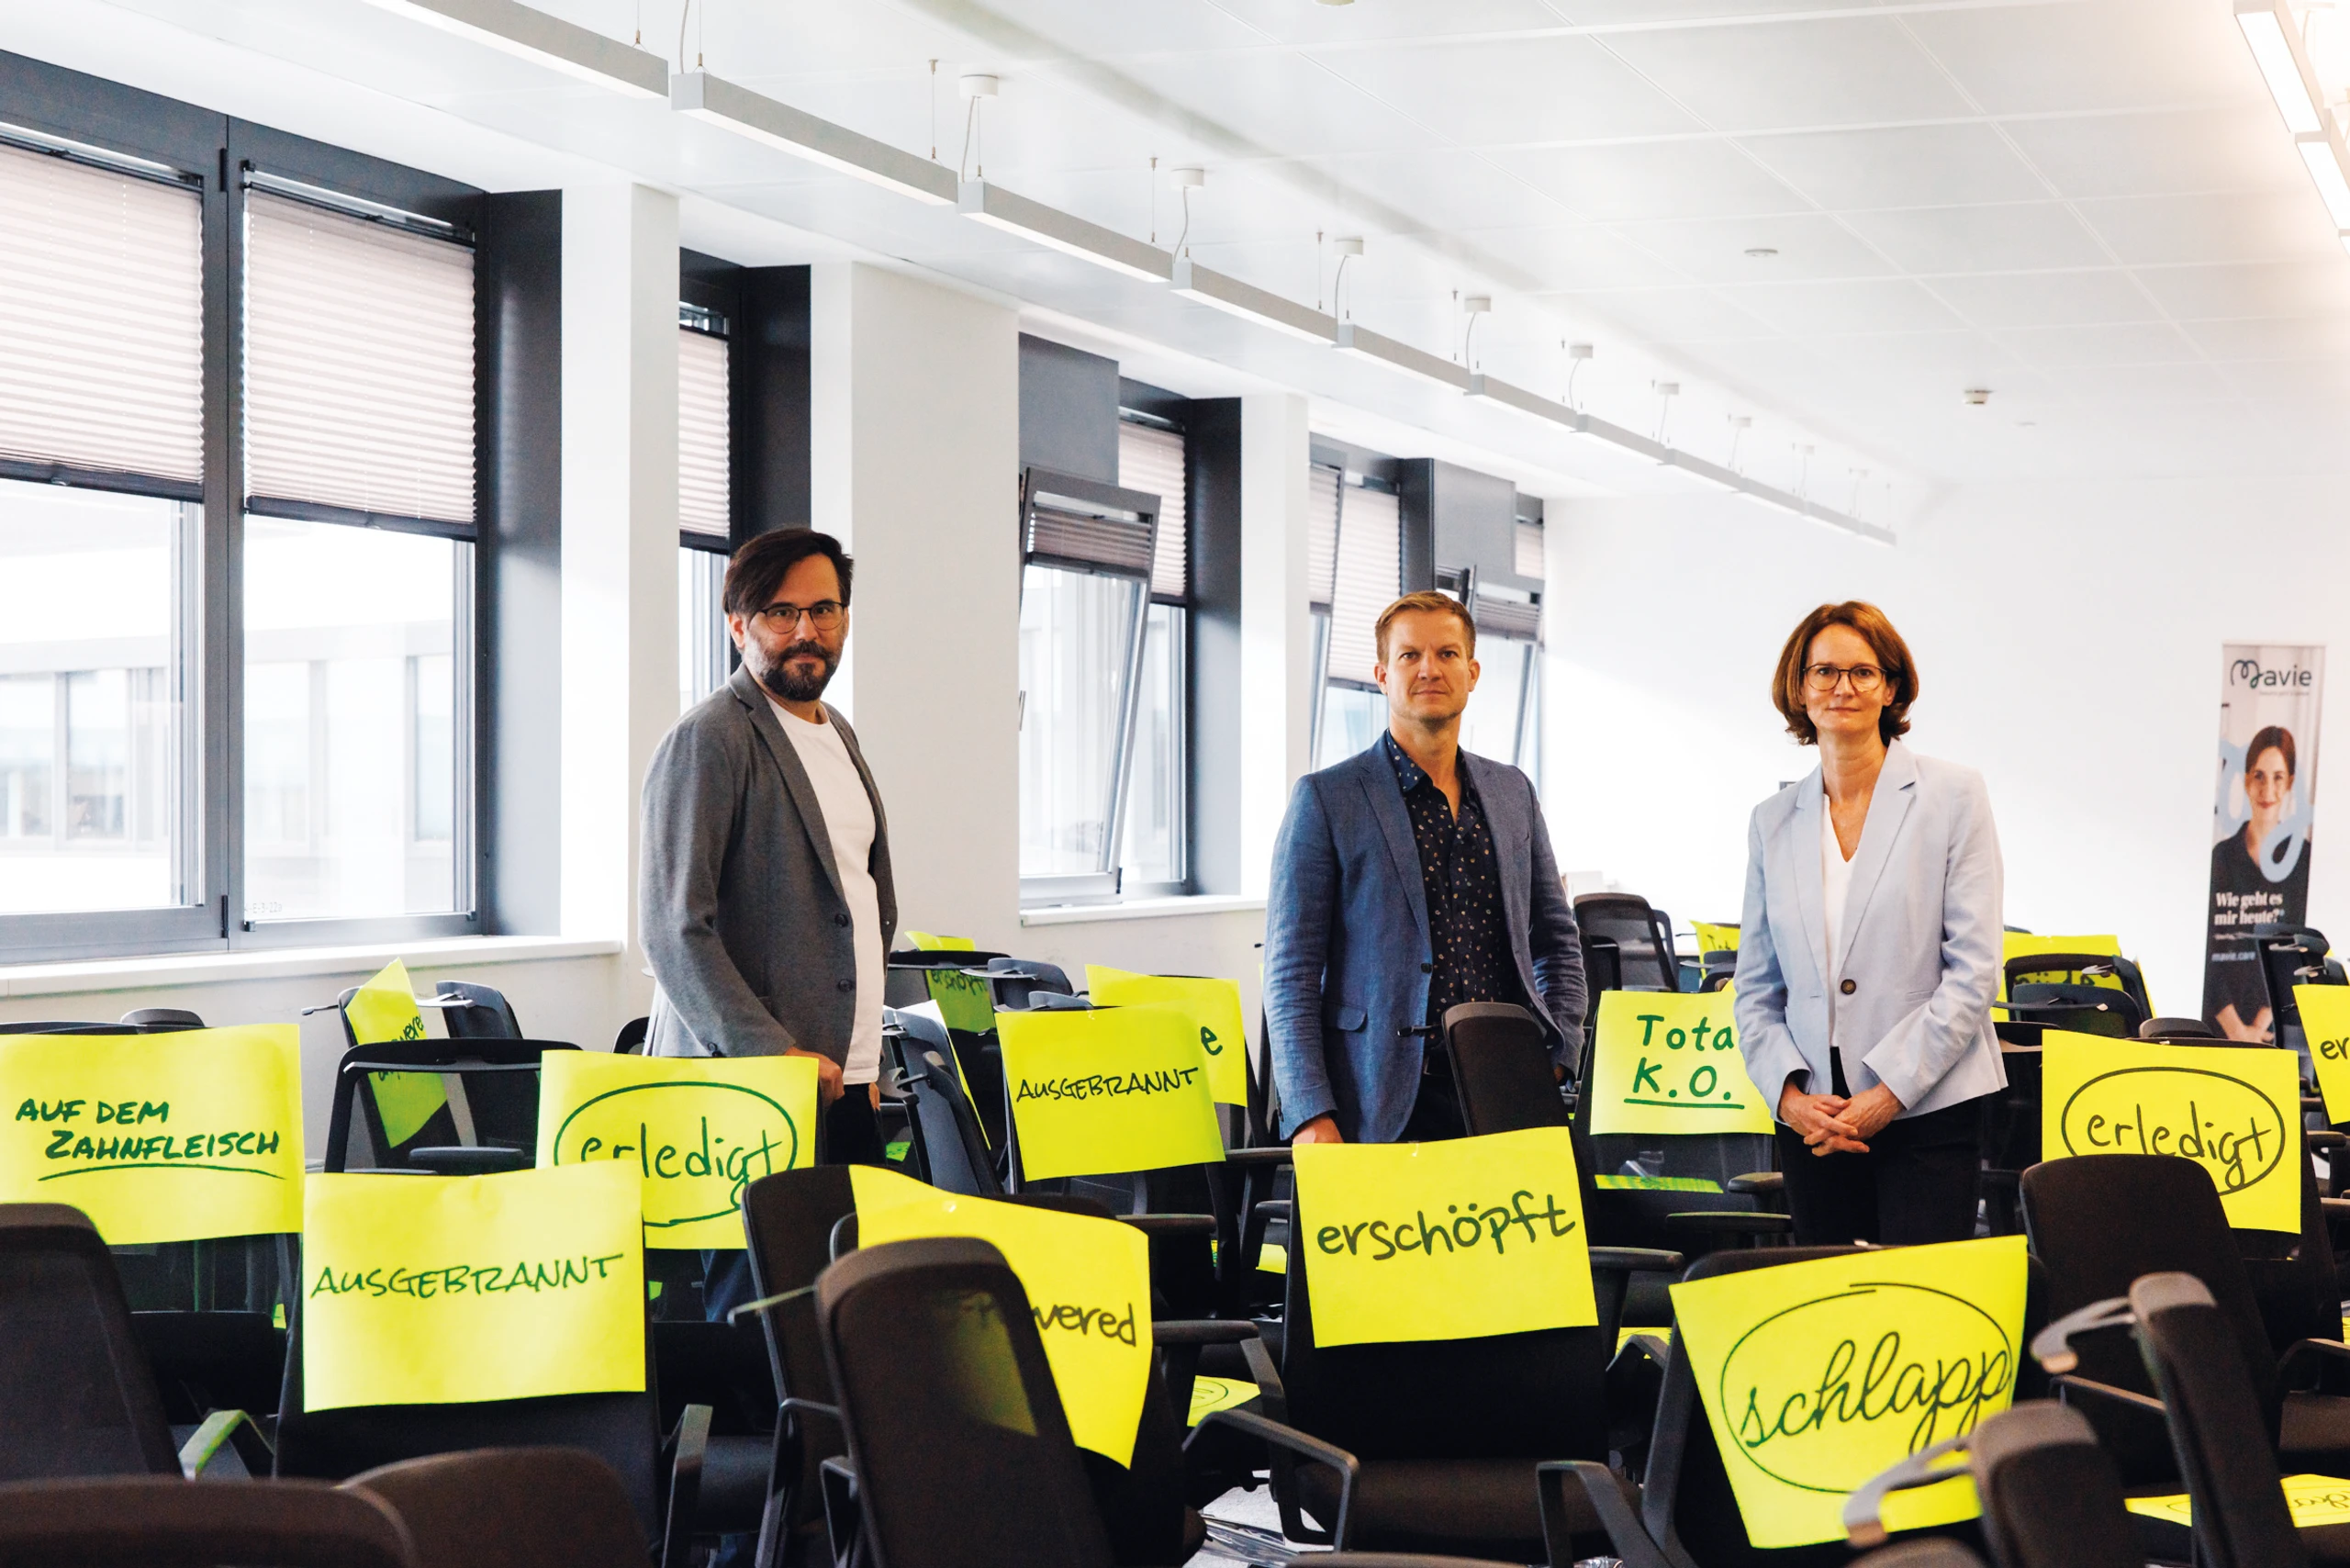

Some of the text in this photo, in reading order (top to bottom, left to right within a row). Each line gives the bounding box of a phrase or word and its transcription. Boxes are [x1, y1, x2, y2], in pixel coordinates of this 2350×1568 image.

[2230, 659, 2312, 689] Mavie
[244, 902, 283, 914] -E-3-22a
[2213, 907, 2279, 925] mir heute?
[2216, 890, 2283, 910] Wie geht es
[1637, 1014, 1735, 1052] Tota
[1016, 1067, 1199, 1103] AUSGEBRANNT
[1633, 1057, 1731, 1101] K.O.
[16, 1098, 170, 1125] AUF DEM
[45, 1130, 280, 1159] ZAHNFLEISCH
[2087, 1101, 2272, 1191] erledigt
[1317, 1191, 1575, 1261] erschöpft
[312, 1254, 624, 1299] AUSGEBRANNT
[1740, 1331, 2011, 1452] schlapp
